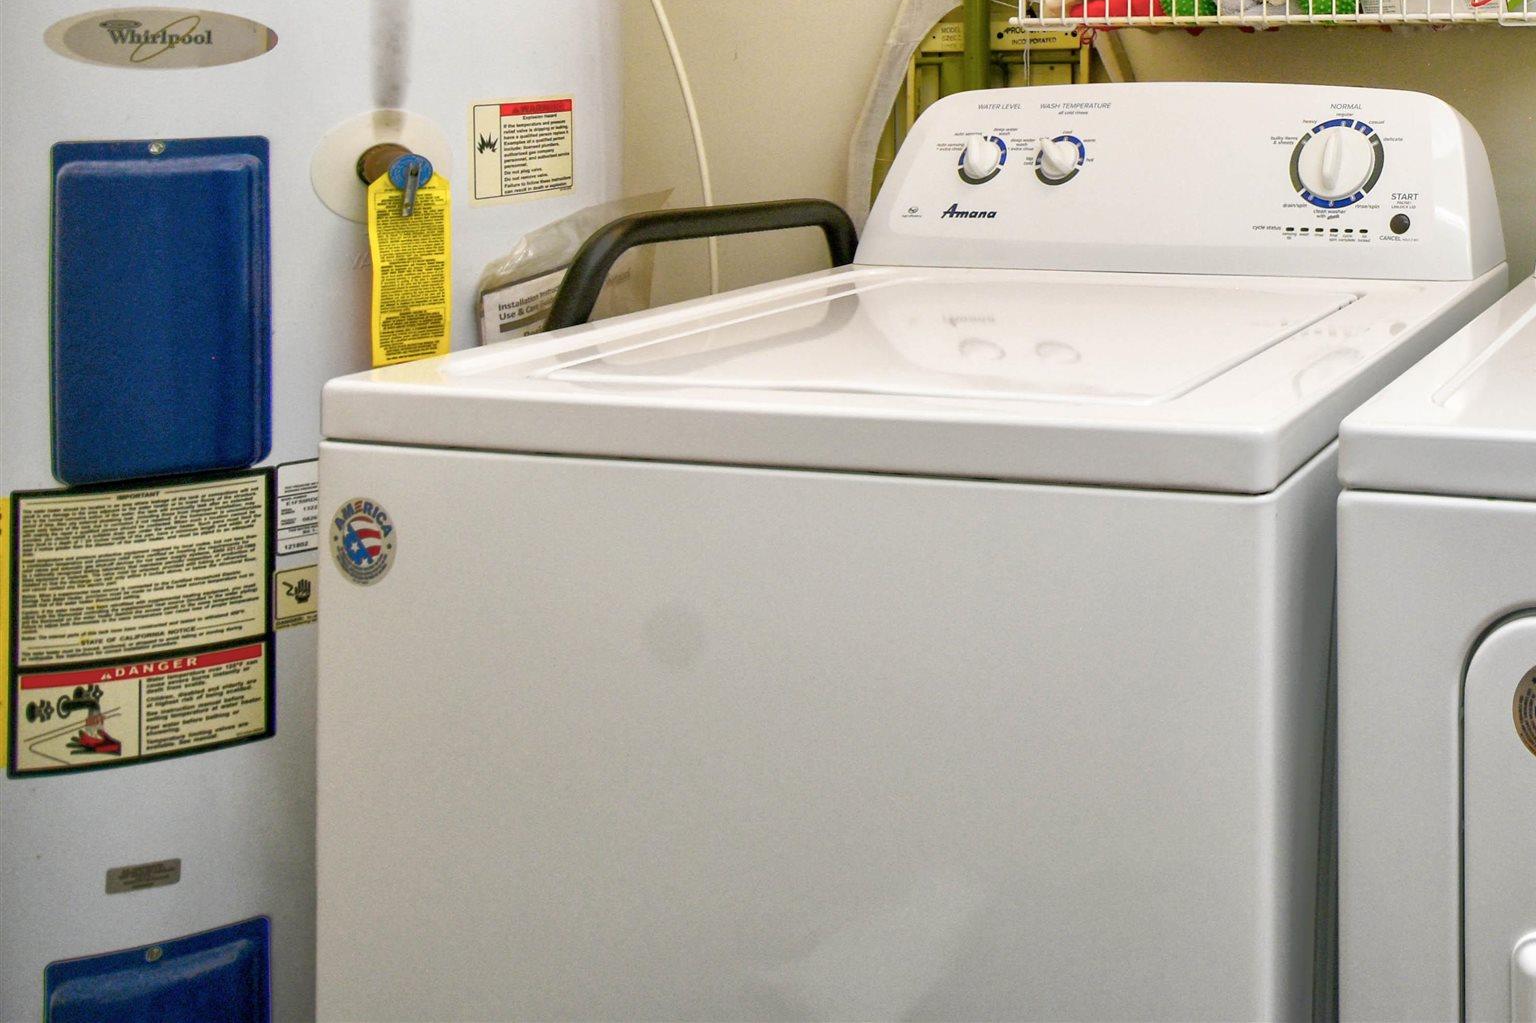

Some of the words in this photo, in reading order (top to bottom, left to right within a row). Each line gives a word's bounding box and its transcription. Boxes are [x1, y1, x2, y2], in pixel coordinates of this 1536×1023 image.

[107, 29, 213, 48] Whirlpool
[1061, 102, 1111, 110] TEMPERATURE
[941, 203, 997, 219] Amana
[498, 293, 540, 312] Installation
[499, 311, 517, 321] Use
[517, 309, 525, 317] &
[117, 491, 162, 501] IMPORTANT
[335, 500, 393, 538] AMERICA
[120, 631, 165, 642] CALIFORNIA
[168, 627, 196, 635] NOTICE
[115, 658, 198, 677] DANGER
